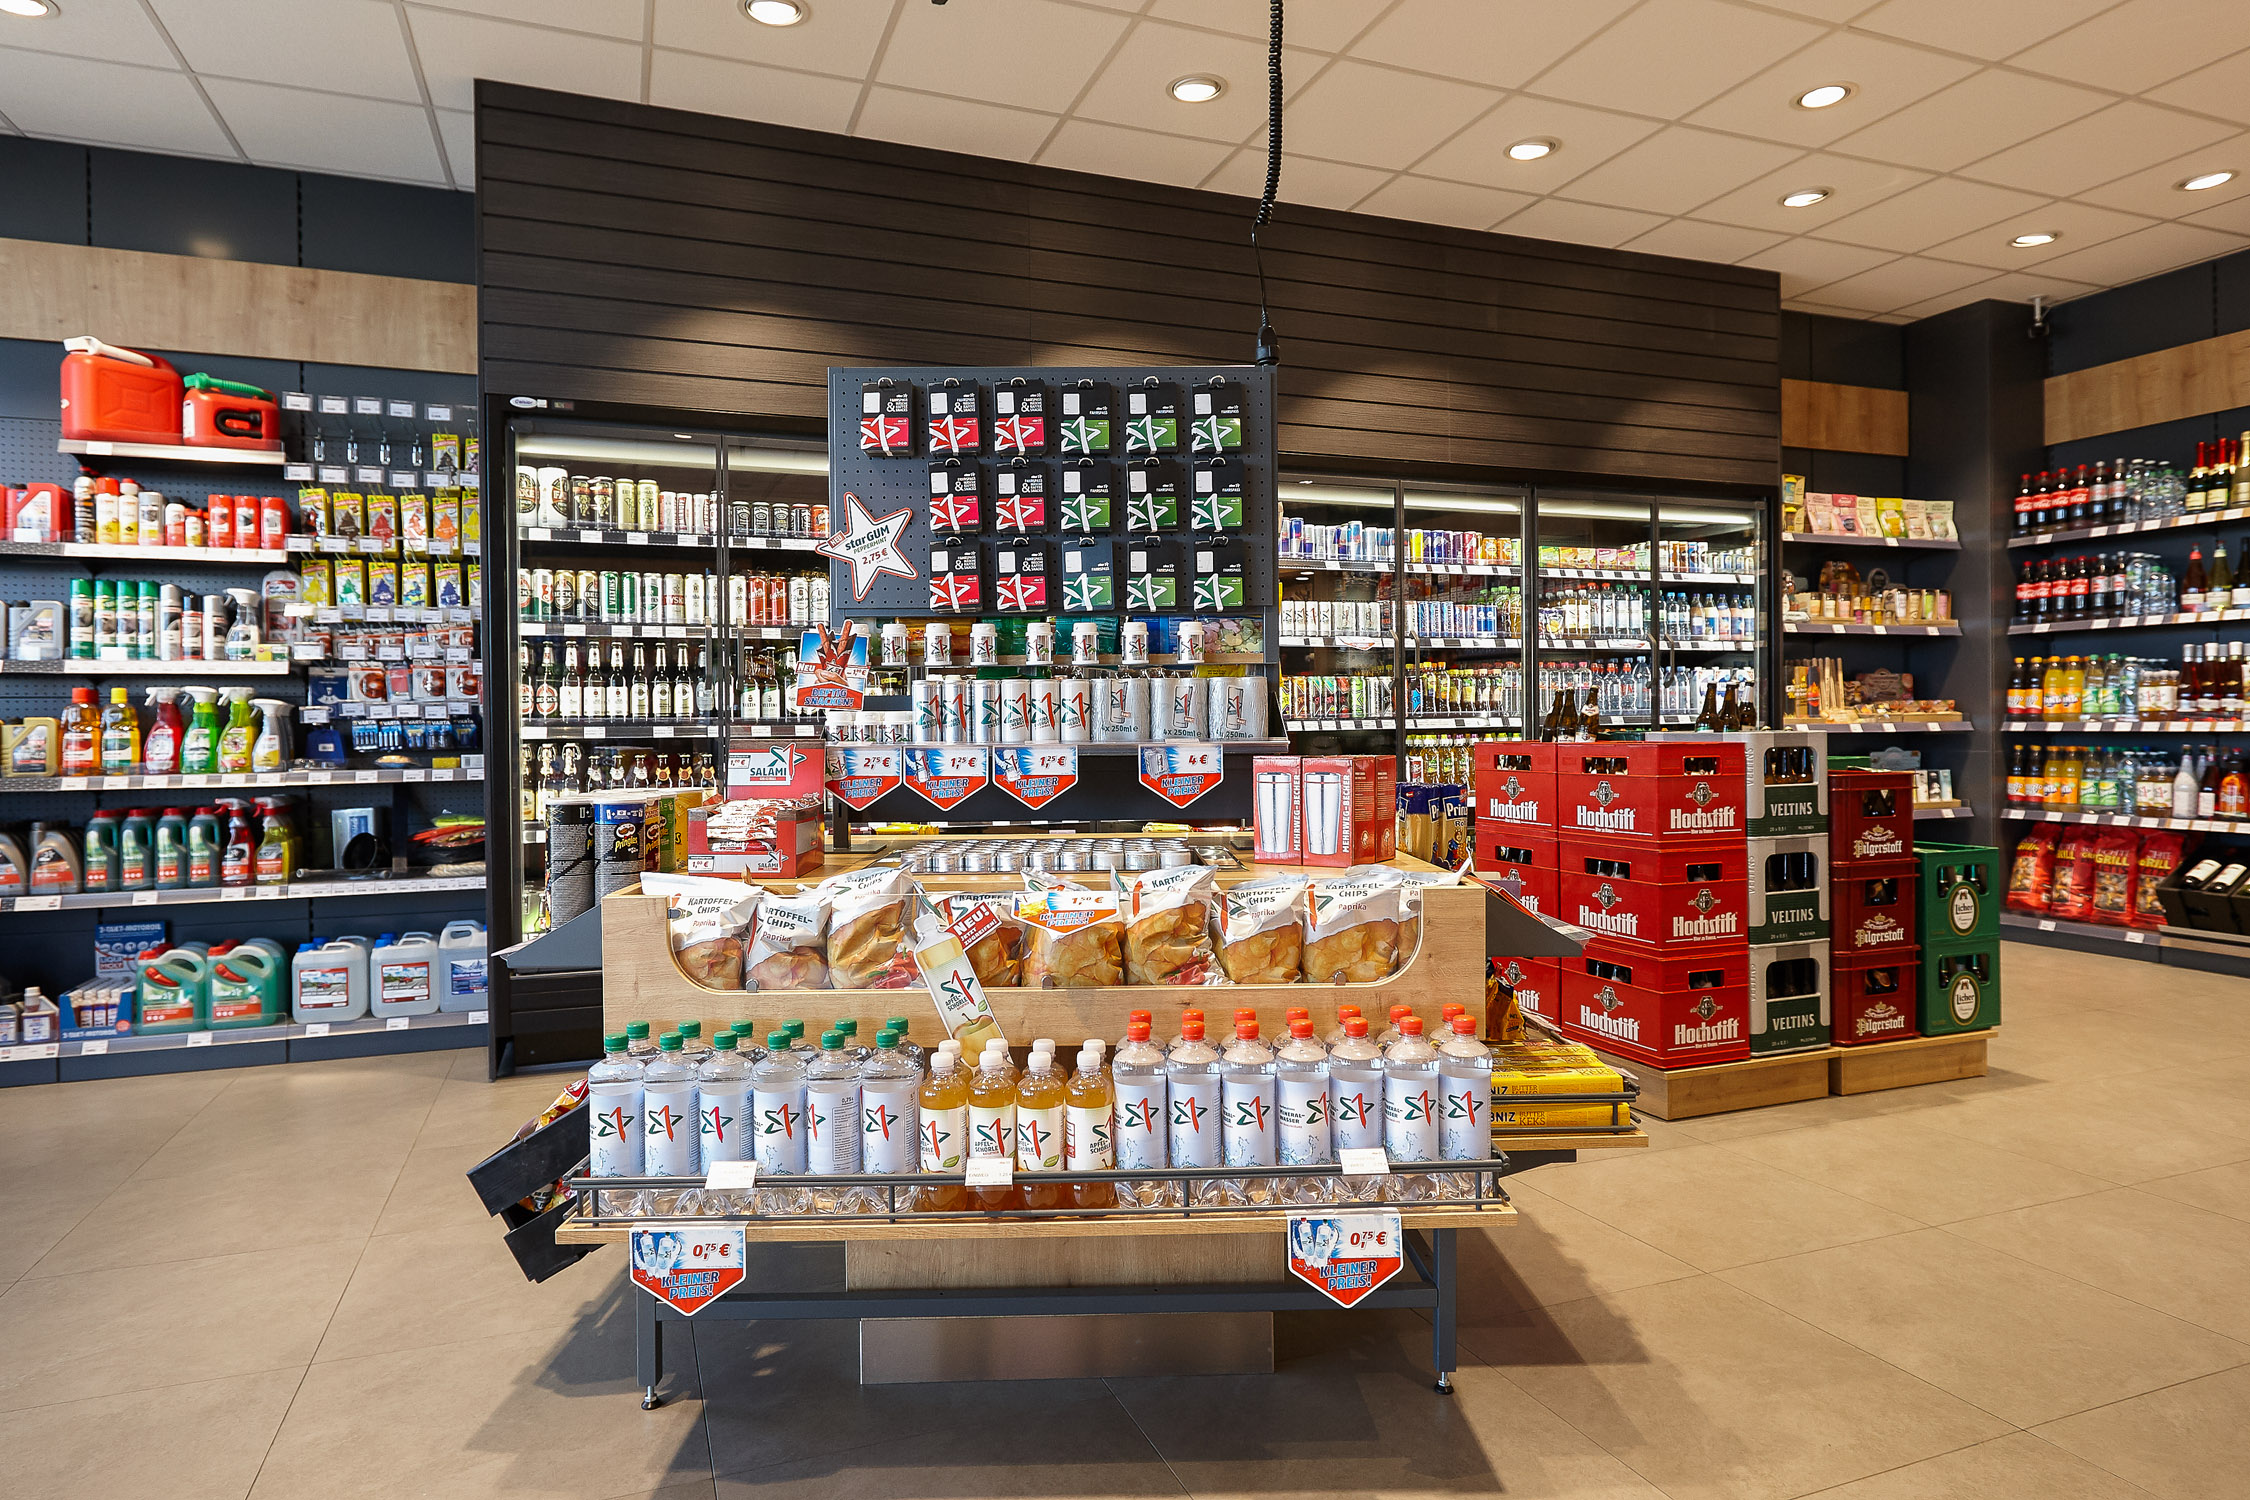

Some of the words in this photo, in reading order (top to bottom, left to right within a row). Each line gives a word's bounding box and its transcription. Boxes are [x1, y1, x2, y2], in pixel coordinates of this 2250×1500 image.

[845, 524, 890, 551] starGUM
[853, 536, 887, 554] PEPPERMINT
[862, 551, 881, 565] 2,75
[882, 548, 888, 556] €
[797, 662, 816, 672] NEU
[812, 688, 847, 698] DEFTIG
[804, 697, 854, 706] SNACKEN!
[864, 756, 880, 769] 2,75
[882, 757, 890, 767] €
[950, 756, 966, 769] 1,25
[968, 757, 976, 768] €
[1040, 755, 1056, 768] 1,25
[1057, 755, 1066, 766] €
[1188, 755, 1196, 765] 4
[1200, 754, 1208, 764] €
[750, 768, 786, 776] SALAMI
[840, 778, 882, 790] KLEINER
[926, 778, 969, 790] KLEINER
[1015, 777, 1059, 789] KLEINER
[1161, 775, 1204, 788] KLEINER
[845, 788, 878, 798] PREIS!
[932, 788, 964, 799] PREIS!
[1021, 786, 1054, 798] PREIS!
[1167, 785, 1200, 797] PREIS!
[1490, 798, 1538, 820] Hochstift
[1770, 802, 1813, 816] VELTINS
[1577, 805, 1636, 830] Hochstift
[1670, 806, 1736, 829] Hochstift
[615, 836, 638, 853] Pringles
[1853, 839, 1903, 858] Pilgerstoff
[2096, 855, 2130, 866] GRILL
[688, 897, 738, 905] KARTOFFEL-
[1249, 897, 1275, 906] CHIPS
[698, 906, 720, 914] CHIPS
[1040, 911, 1094, 921] KLEINER
[1772, 908, 1814, 924] VELTINS
[1955, 904, 1973, 915] Licher
[766, 916, 796, 930] CHIPS
[953, 904, 990, 936] NEU!
[1046, 918, 1089, 927] PREIS!
[1579, 905, 1638, 936] Hochstift
[1673, 912, 1738, 937] Hochstift
[762, 931, 792, 942] Paprika
[960, 927, 977, 942] JETZT
[964, 919, 997, 946] ZUGREIFEN!
[1855, 928, 1904, 947] Pilgerstoff
[945, 995, 962, 1006] APFEL-
[947, 997, 968, 1012] SCHORLE
[1956, 994, 1974, 1005] Licher
[1580, 1004, 1640, 1041] Hochstift
[1772, 1013, 1815, 1031] VELTINS
[1856, 1016, 1905, 1036] Pilgerstoff
[1675, 1017, 1739, 1045] Hochstift
[1280, 1110, 1305, 1118] MINERAL-
[1280, 1116, 1299, 1124] WASSER
[975, 1139, 994, 1147] APFEL-
[1089, 1140, 1108, 1150] APFEL-
[1089, 1143, 1110, 1154] SCHORLE
[1350, 1231, 1373, 1248] 0,75
[1376, 1231, 1386, 1245] €
[693, 1243, 717, 1260] 0,75
[719, 1244, 730, 1256] €
[1320, 1260, 1377, 1278] KLEINER
[661, 1271, 720, 1288] KLEINER
[1328, 1274, 1372, 1291] PREIS!
[669, 1284, 714, 1300] PREIS!
